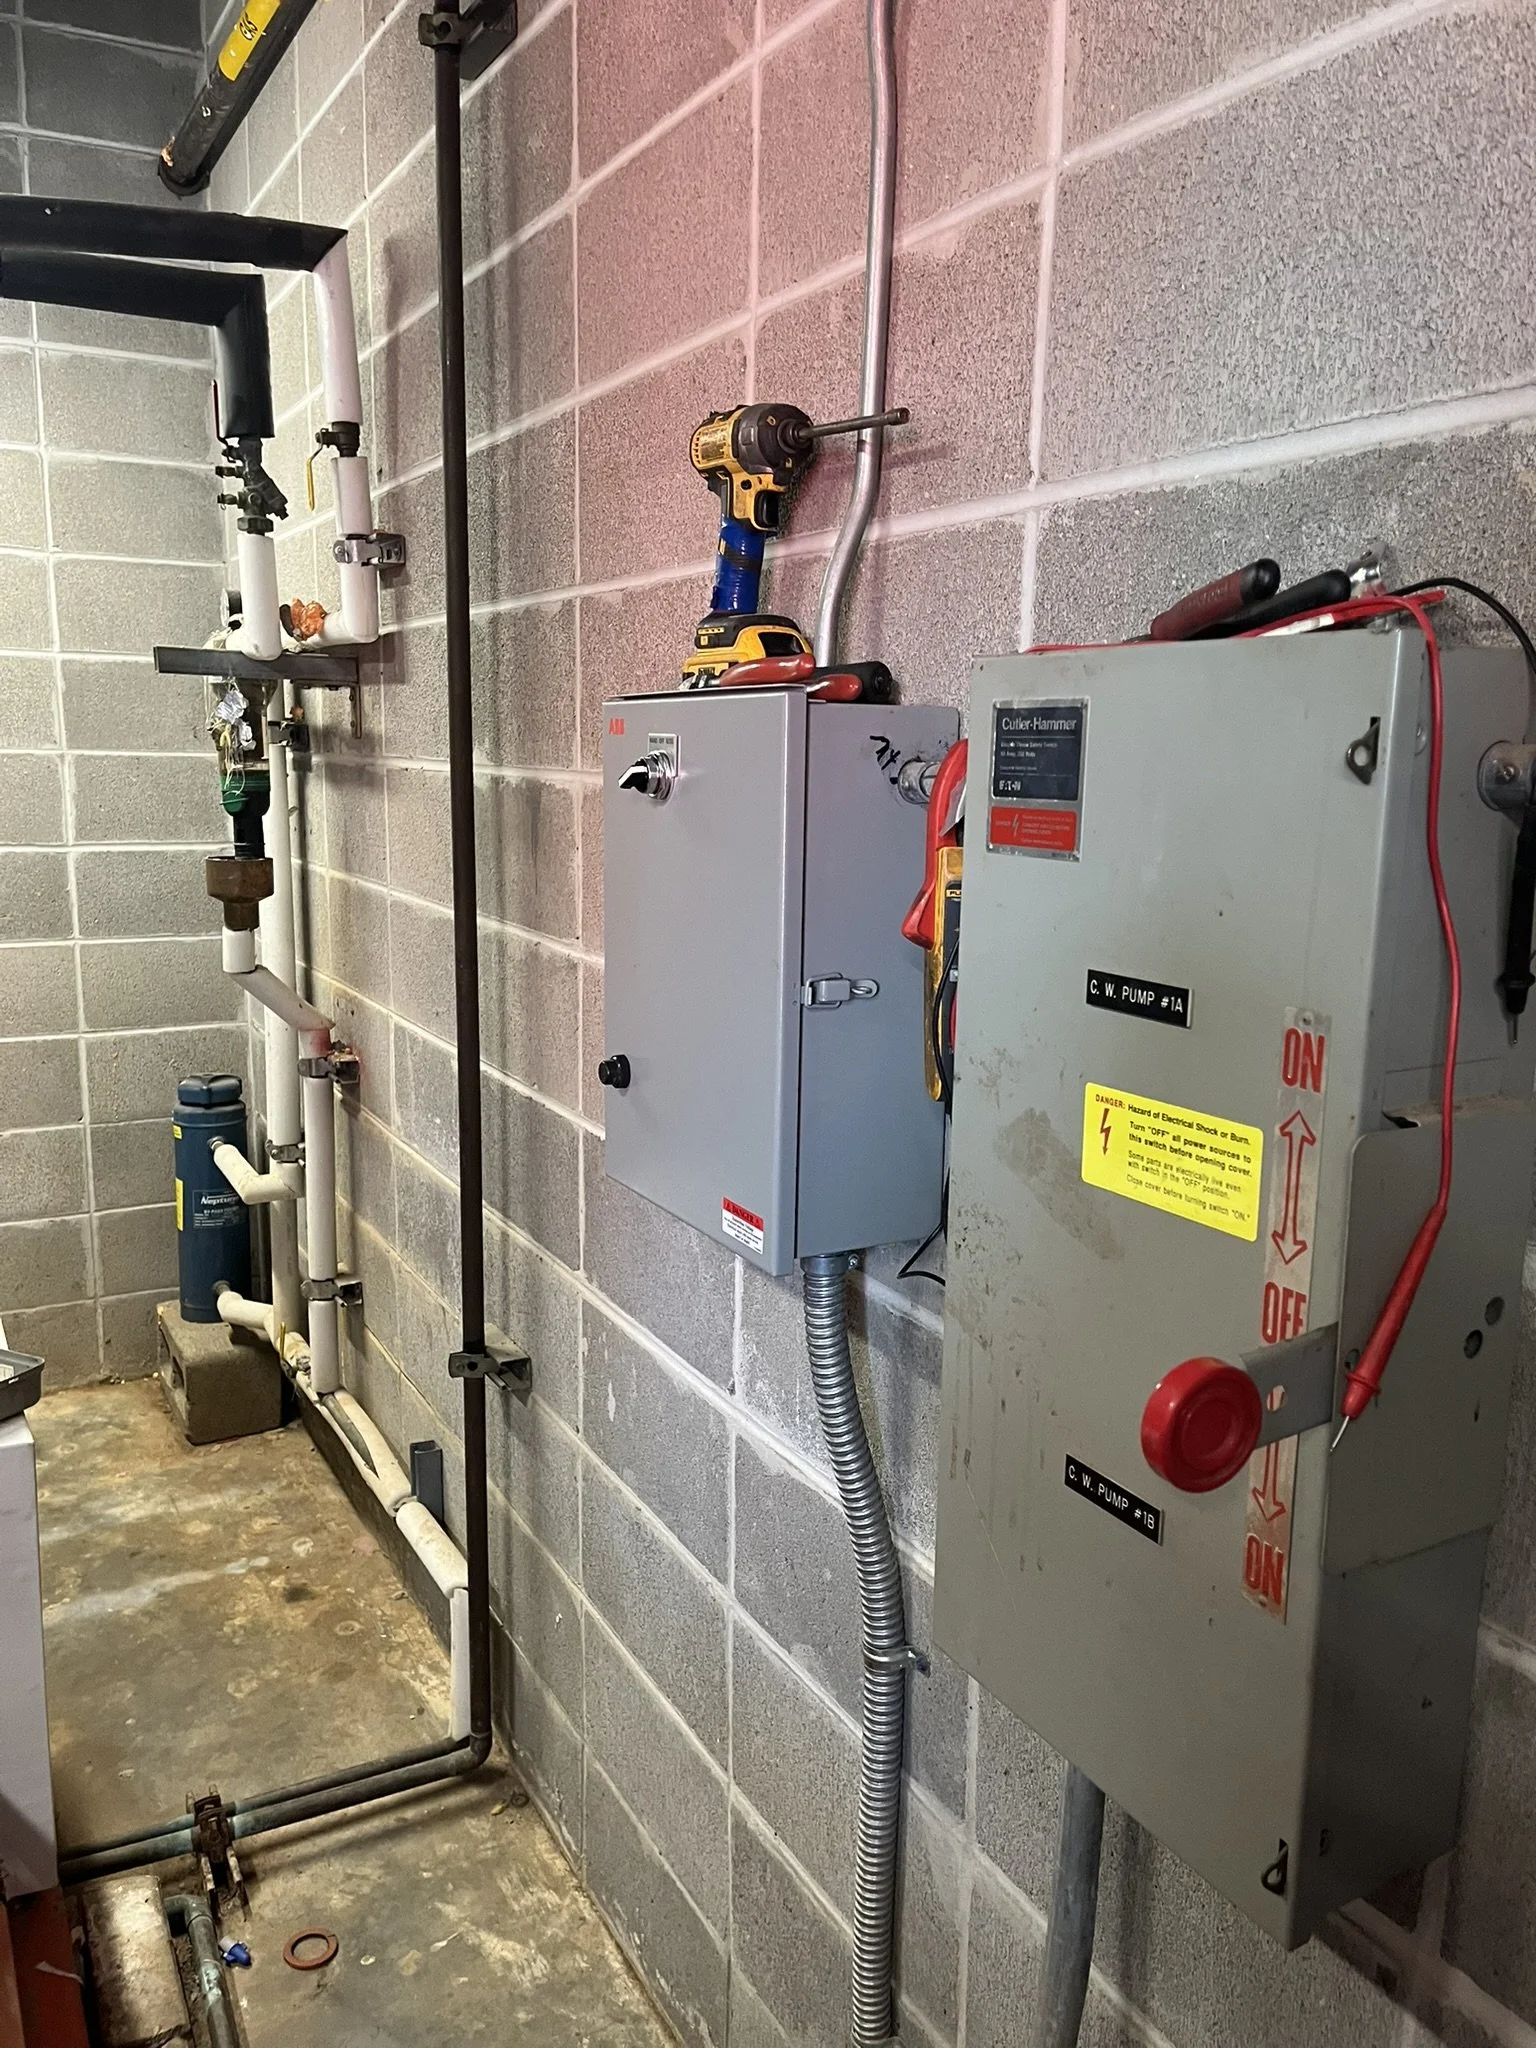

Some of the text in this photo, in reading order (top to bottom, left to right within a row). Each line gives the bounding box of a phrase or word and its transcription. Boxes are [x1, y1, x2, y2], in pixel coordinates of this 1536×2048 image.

[1090, 979, 1183, 1013] C. W. PUMP #1A
[1283, 1027, 1325, 1094] ON
[1096, 1094, 1251, 1145] DANGER: Hazard of Electrical Shock or Burn.
[1128, 1150, 1144, 1162] Some
[1147, 1156, 1161, 1168] parts
[1164, 1162, 1173, 1170] are
[1129, 1121, 1251, 1163] Turn "OFF" all power sources to
[1129, 1133, 1142, 1143] this
[1145, 1138, 1167, 1151] switch
[1170, 1145, 1193, 1159] before
[1195, 1154, 1226, 1171] opening
[1127, 1174, 1143, 1186] Close
[1145, 1182, 1161, 1191] cover
[1141, 1165, 1160, 1176] switch
[1262, 1281, 1307, 1344] OFF
[1068, 1465, 1155, 1530] C. W. PUMP #1B
[1246, 1535, 1284, 1605] ON
